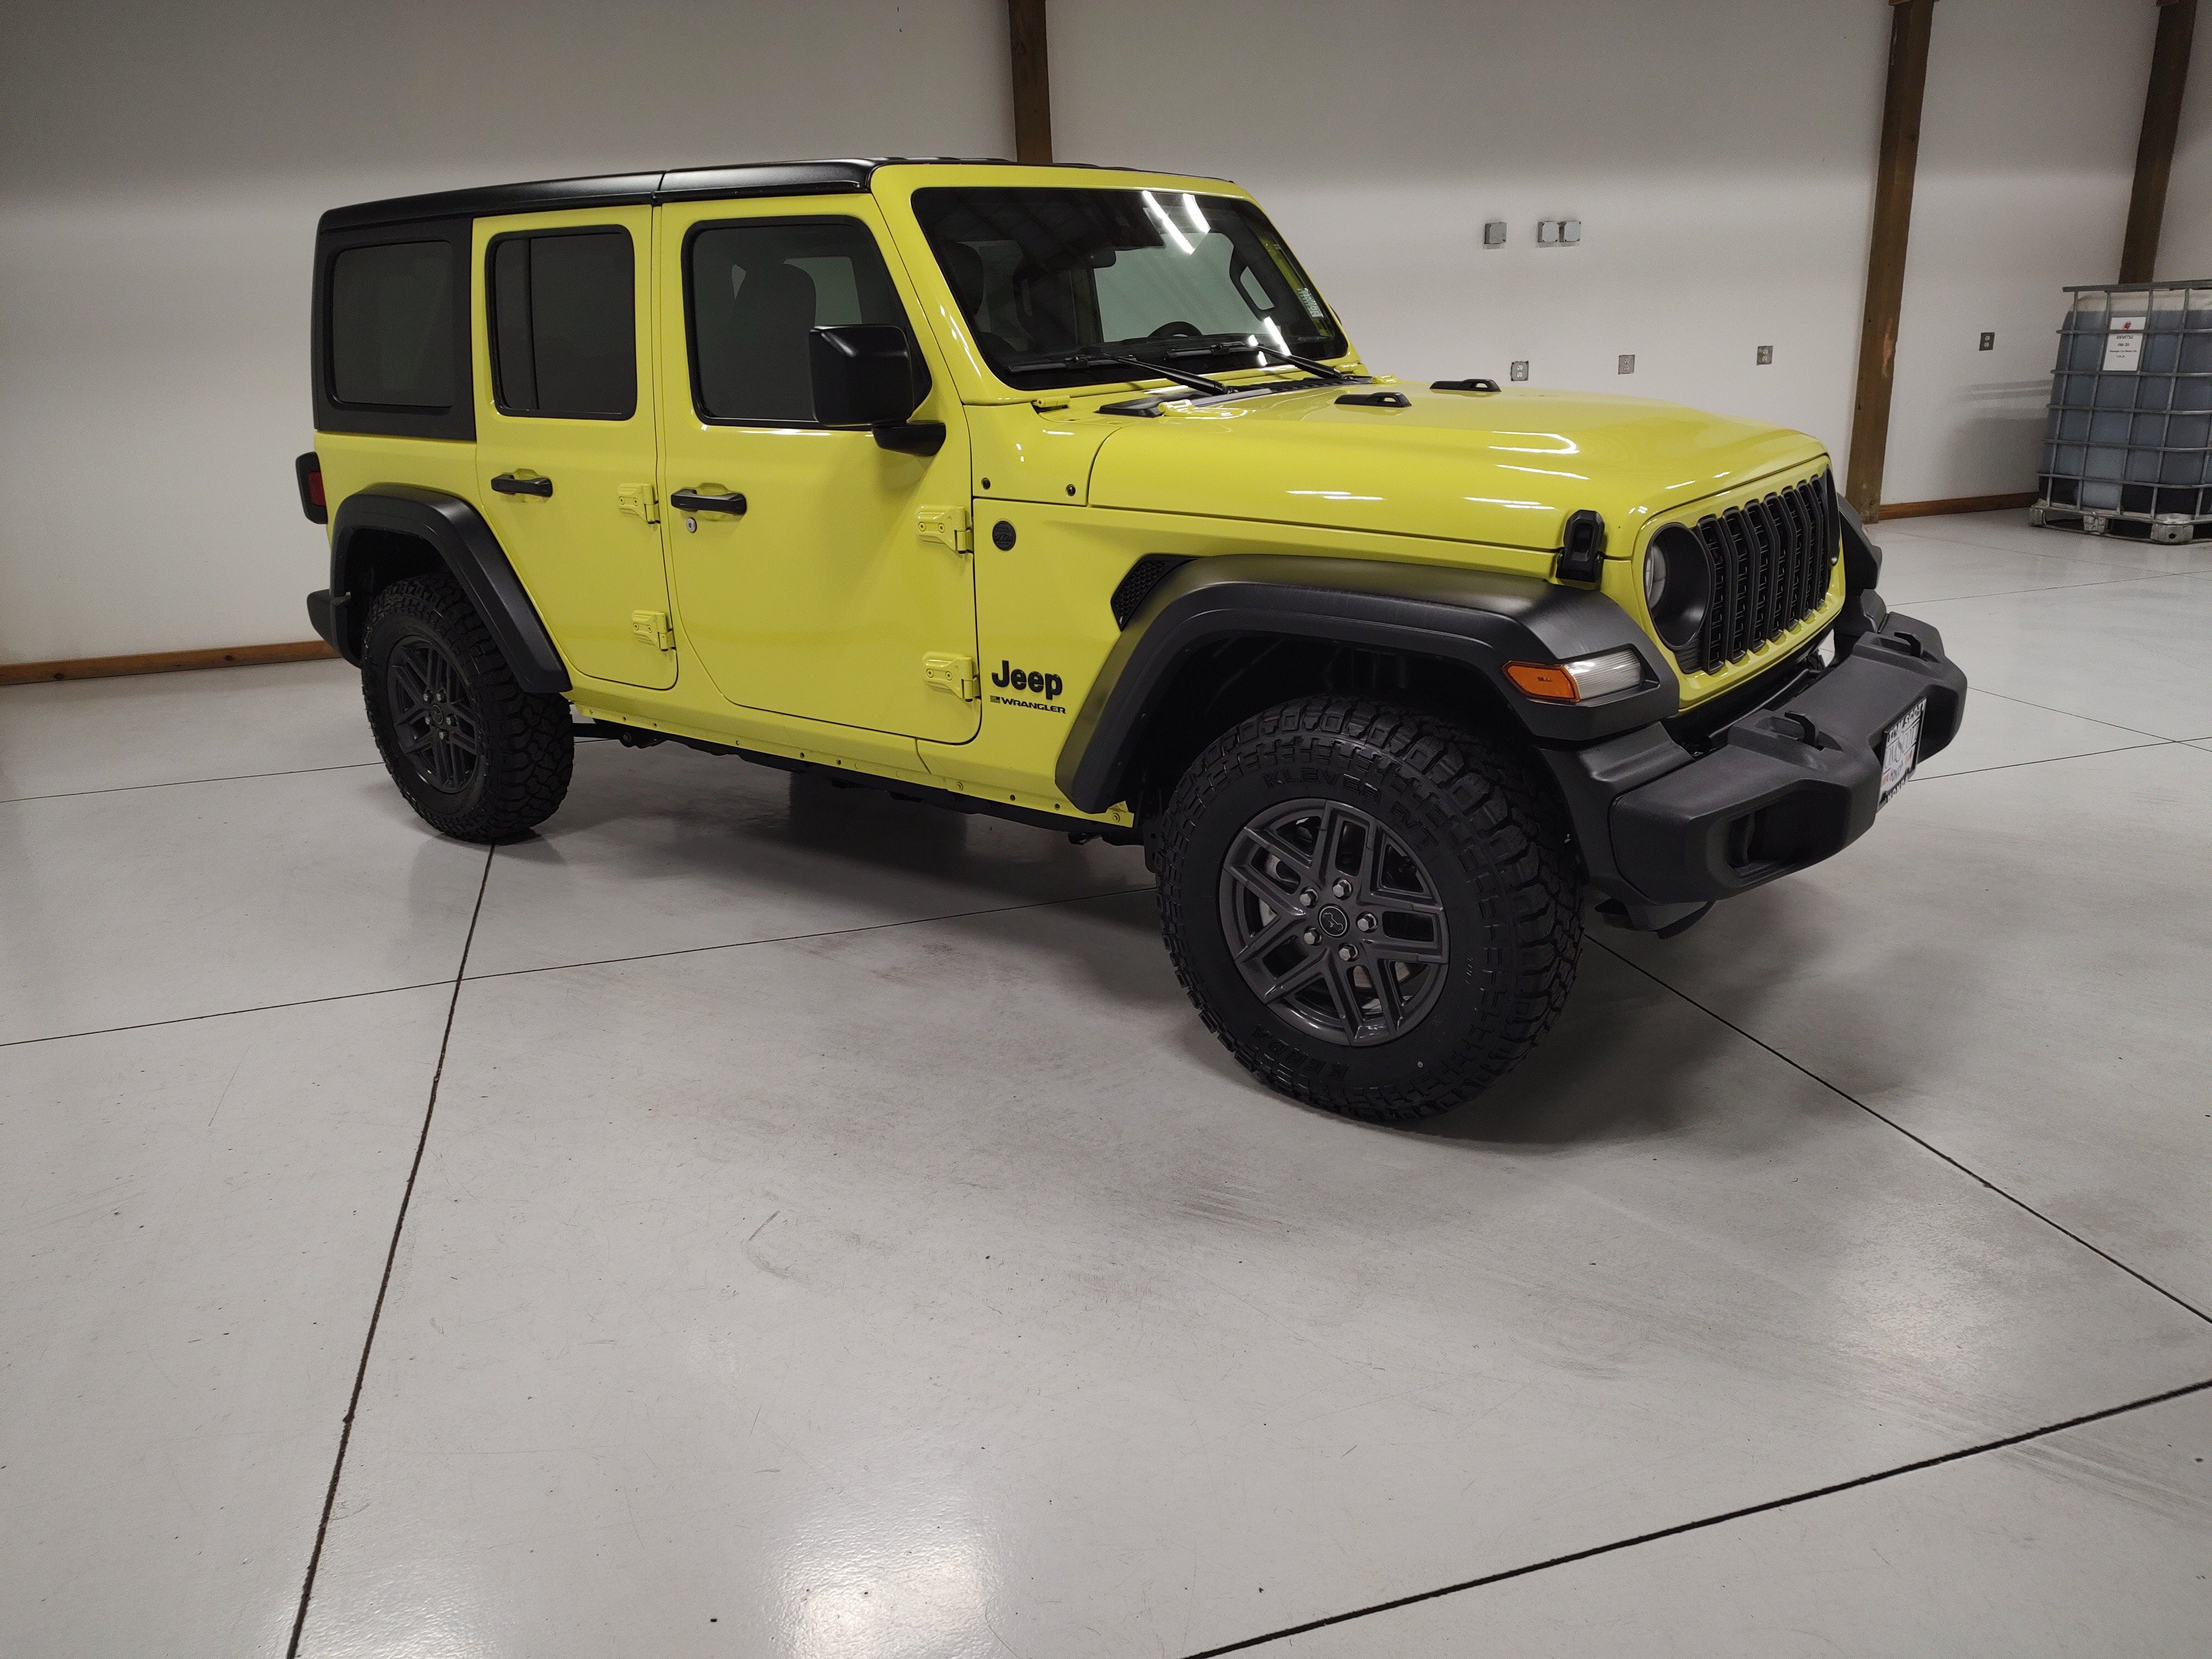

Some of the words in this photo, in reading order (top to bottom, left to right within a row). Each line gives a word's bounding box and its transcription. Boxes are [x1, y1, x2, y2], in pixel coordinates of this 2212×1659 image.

[992, 660, 1062, 700] Jeep
[1001, 697, 1066, 714] WRANGLER
[1262, 767, 1381, 804] KLEVER
[1251, 1024, 1350, 1081] KENDA
